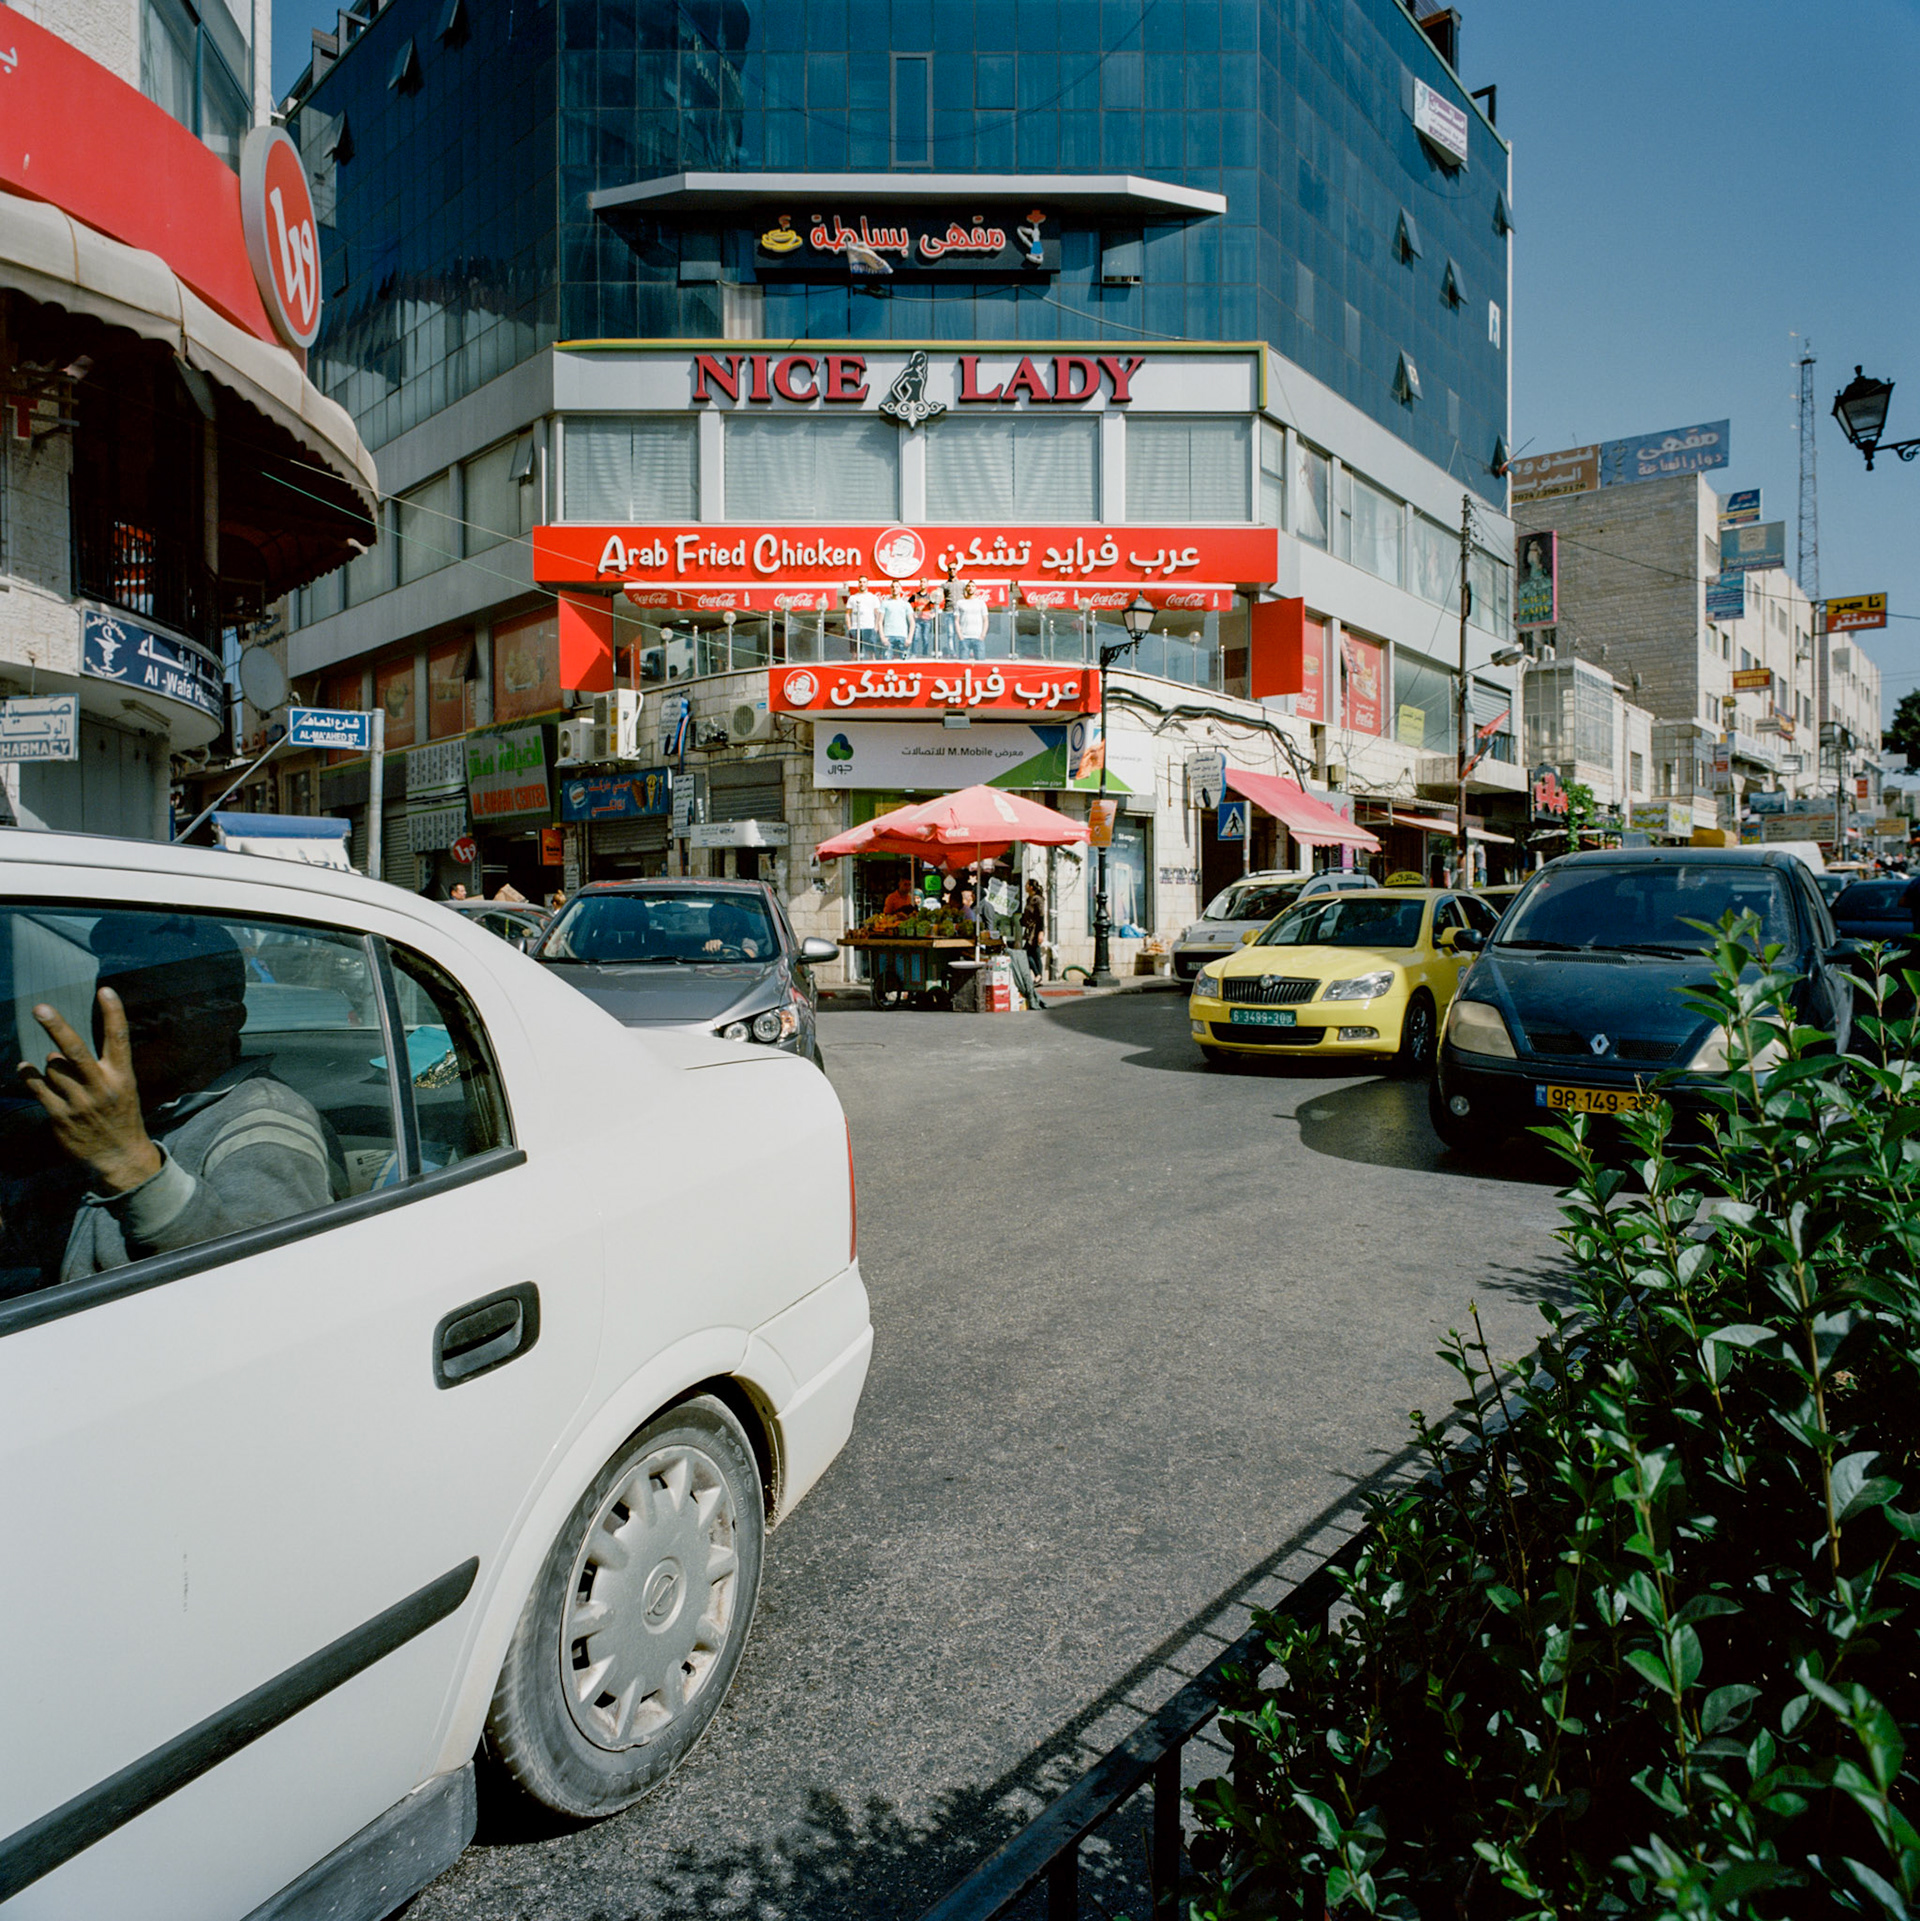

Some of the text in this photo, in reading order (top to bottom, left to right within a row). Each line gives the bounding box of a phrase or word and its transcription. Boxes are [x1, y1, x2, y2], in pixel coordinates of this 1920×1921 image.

[810, 214, 1006, 259] مقهى بساطة
[693, 355, 1146, 403] NICE LADY
[598, 534, 862, 573] Arab Fried Chicken
[937, 535, 1201, 574] عرب فرايد تشكن
[1833, 613, 1880, 631] سنتر
[830, 667, 1080, 708] عرب فرايد تشكن
[300, 716, 360, 731] شارع المعاه
[901, 747, 1024, 757] معرض M.Mobile للاتصالات
